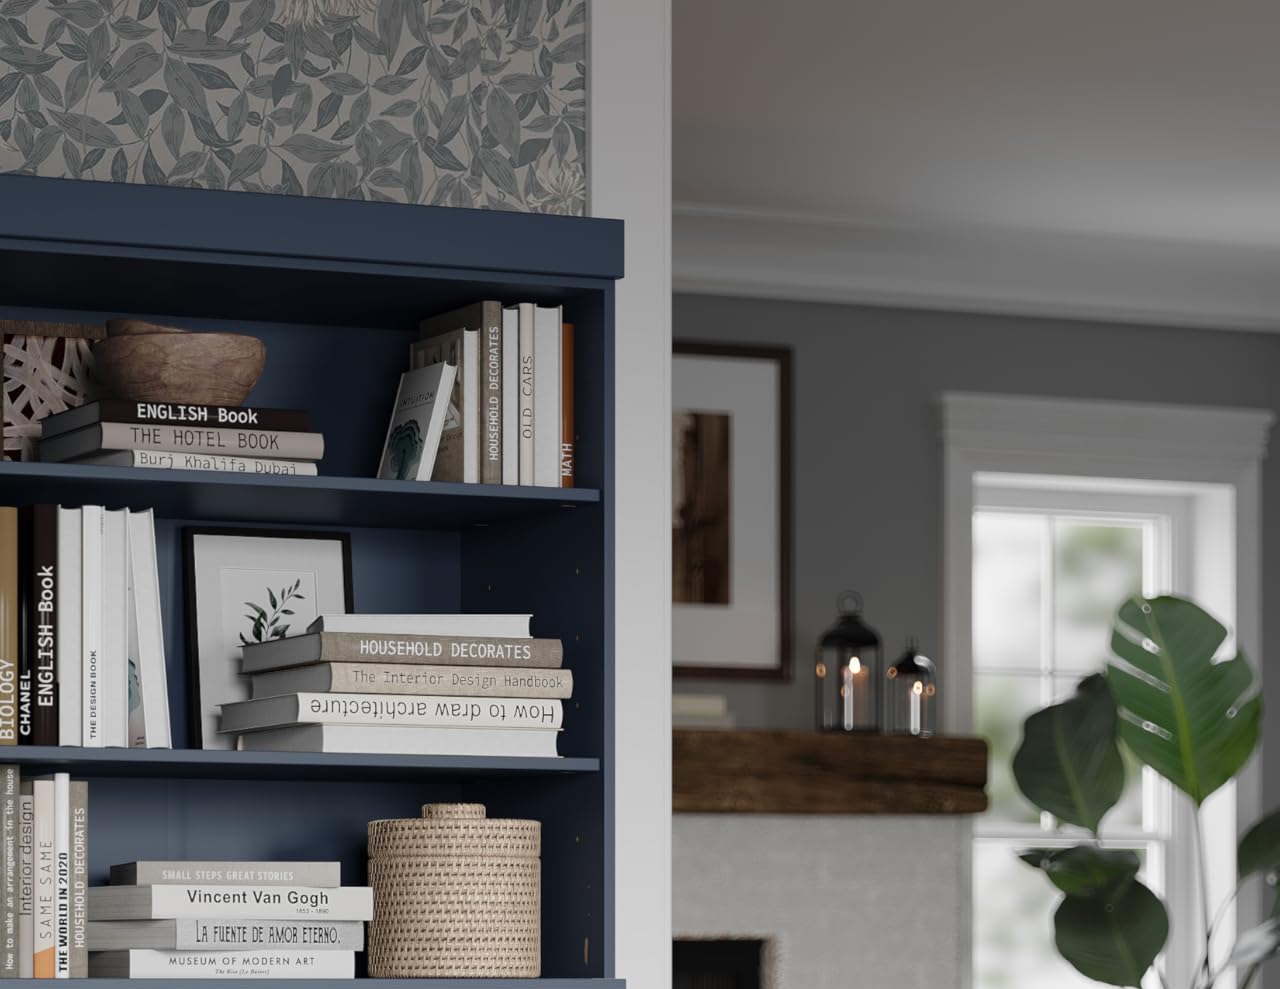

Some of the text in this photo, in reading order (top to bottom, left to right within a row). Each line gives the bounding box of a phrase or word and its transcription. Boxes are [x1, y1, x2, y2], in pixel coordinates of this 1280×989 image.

[488, 326, 500, 461] HOUSEHOLD DECORATES
[522, 354, 532, 439] OLD CARS
[136, 402, 259, 425] ENGLISH Book
[130, 427, 280, 450] THE HOTEL BOOK
[140, 452, 296, 475] Burj Khalifa Dubai
[561, 443, 573, 477] MATH
[36, 565, 54, 707] ENGLISH Book
[359, 639, 531, 660] HOUSEHOLD DECORATES
[89, 650, 97, 740] THE DESIGN BOOK
[353, 670, 564, 689] The Interior Design Handbook
[19, 669, 31, 736] CHANEL
[310, 699, 554, 724] How to draw architecture
[4, 768, 18, 970] How to make an arrangement in the house
[19, 801, 34, 916] Interior design
[161, 869, 294, 882] SMALL STEPS GREAT STORIES
[39, 840, 52, 939] SAME SAME
[74, 807, 85, 948] HOUSEHOLD DECORATES
[58, 852, 68, 973] THE WORLD IN 2020
[186, 889, 329, 908] Vincent Van Gogh
[213, 925, 247, 943] FUENTE
[252, 926, 264, 943] DE
[268, 927, 298, 943] AMOR
[302, 926, 341, 944] ETERNO.
[168, 957, 316, 966] MUSEUM OF MODERN ART
